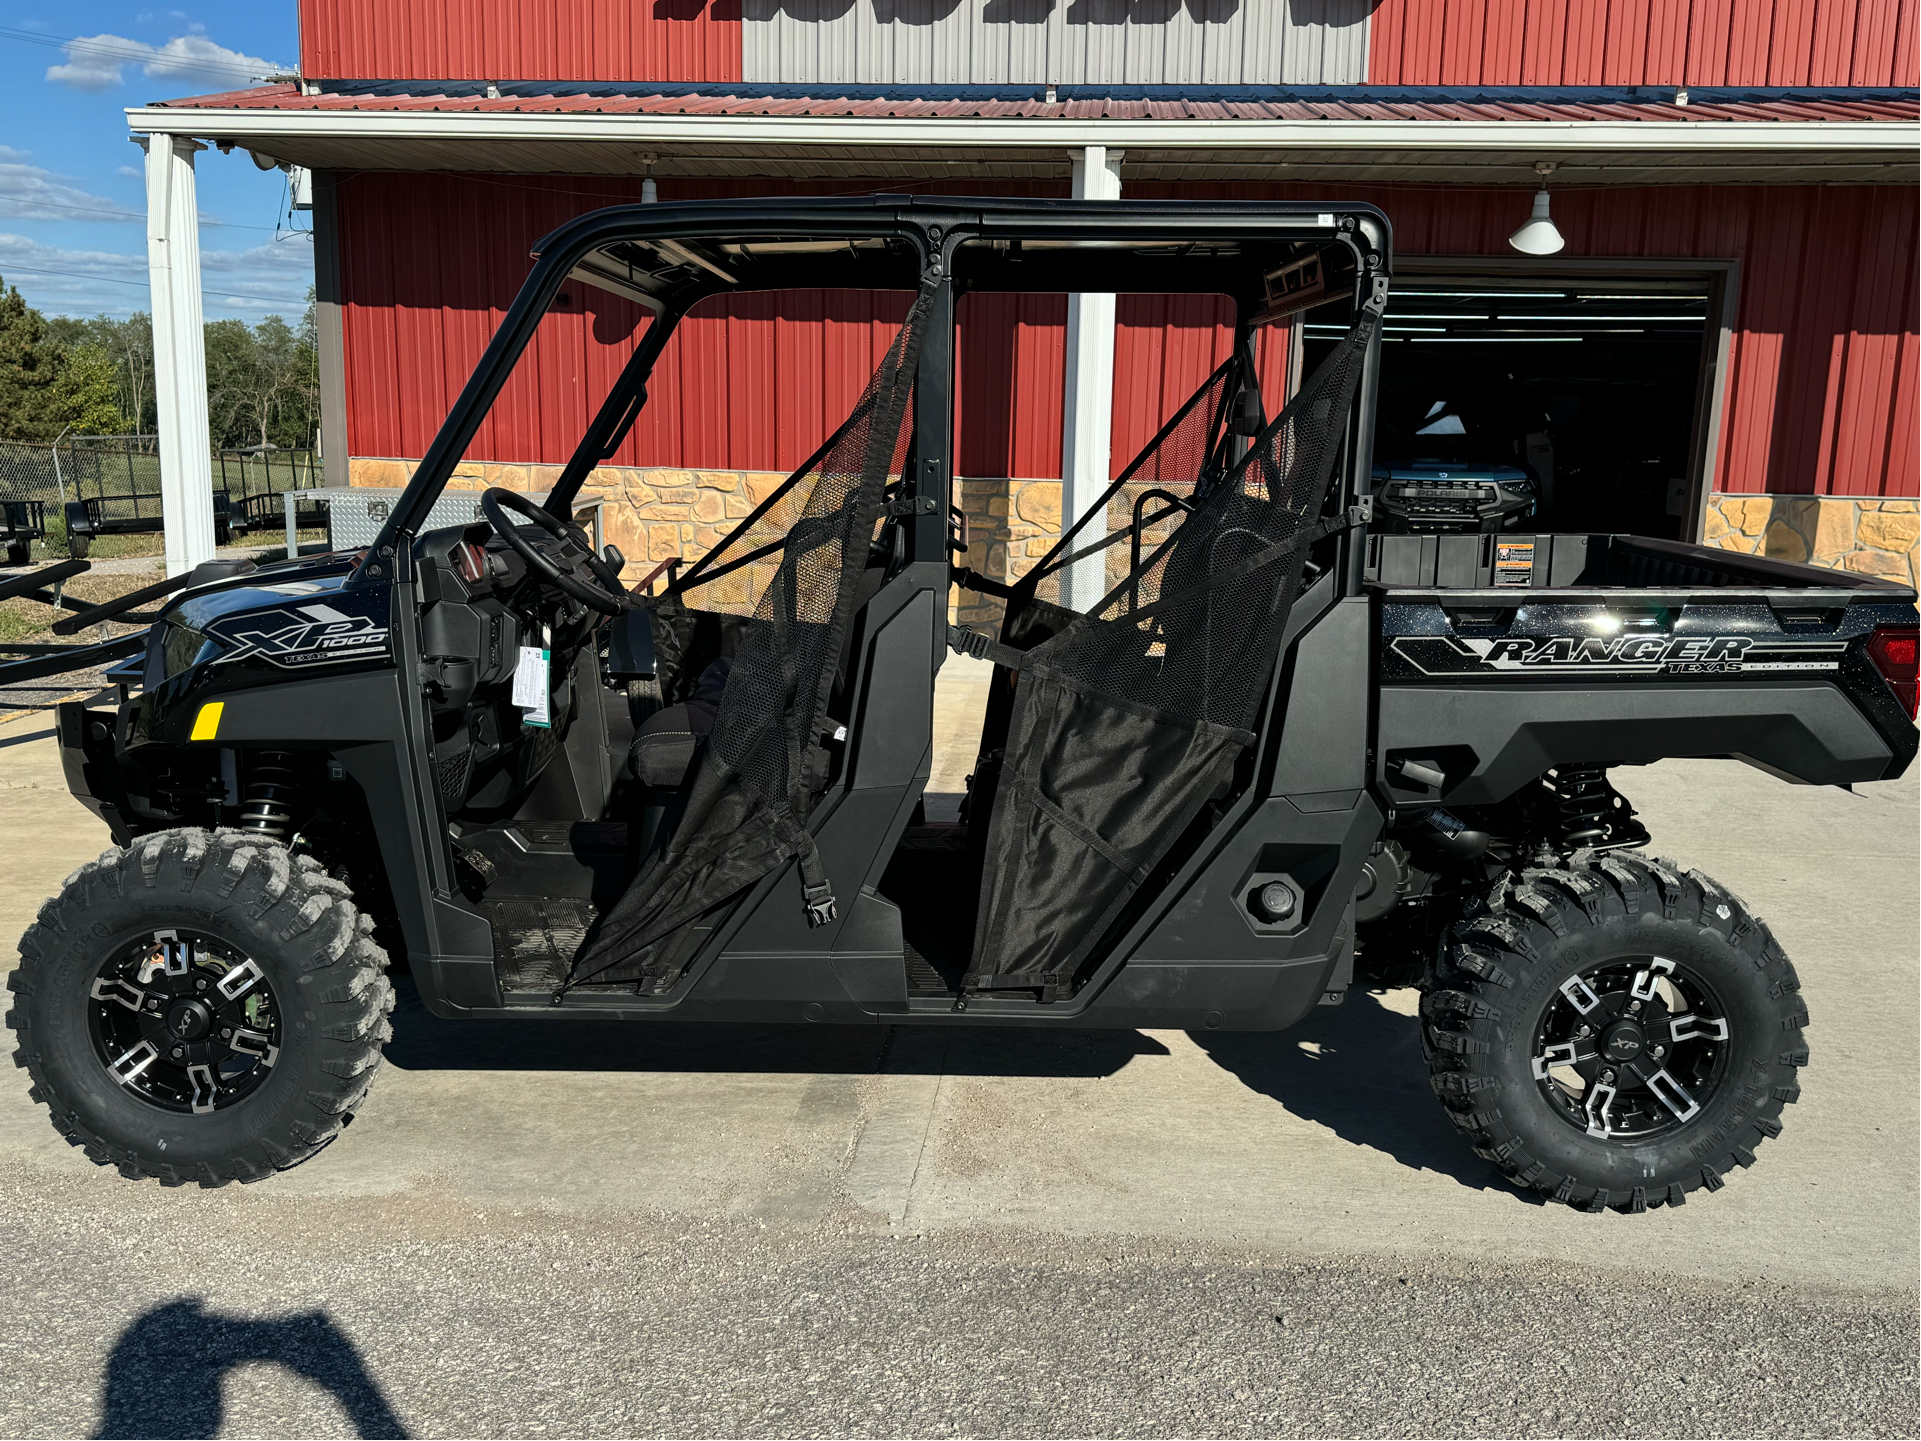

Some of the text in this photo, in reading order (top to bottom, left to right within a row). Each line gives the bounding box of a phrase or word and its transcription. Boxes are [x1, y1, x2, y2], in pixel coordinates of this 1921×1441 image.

[1417, 489, 1467, 498] POLARIS
[211, 616, 376, 665] XP
[321, 635, 386, 648] 1000
[1479, 636, 1755, 663] RANGER
[283, 651, 330, 664] TEXAS
[1667, 661, 1830, 674] TEXAS EDITION
[177, 1009, 192, 1036] XP
[1610, 1037, 1640, 1050] XP
